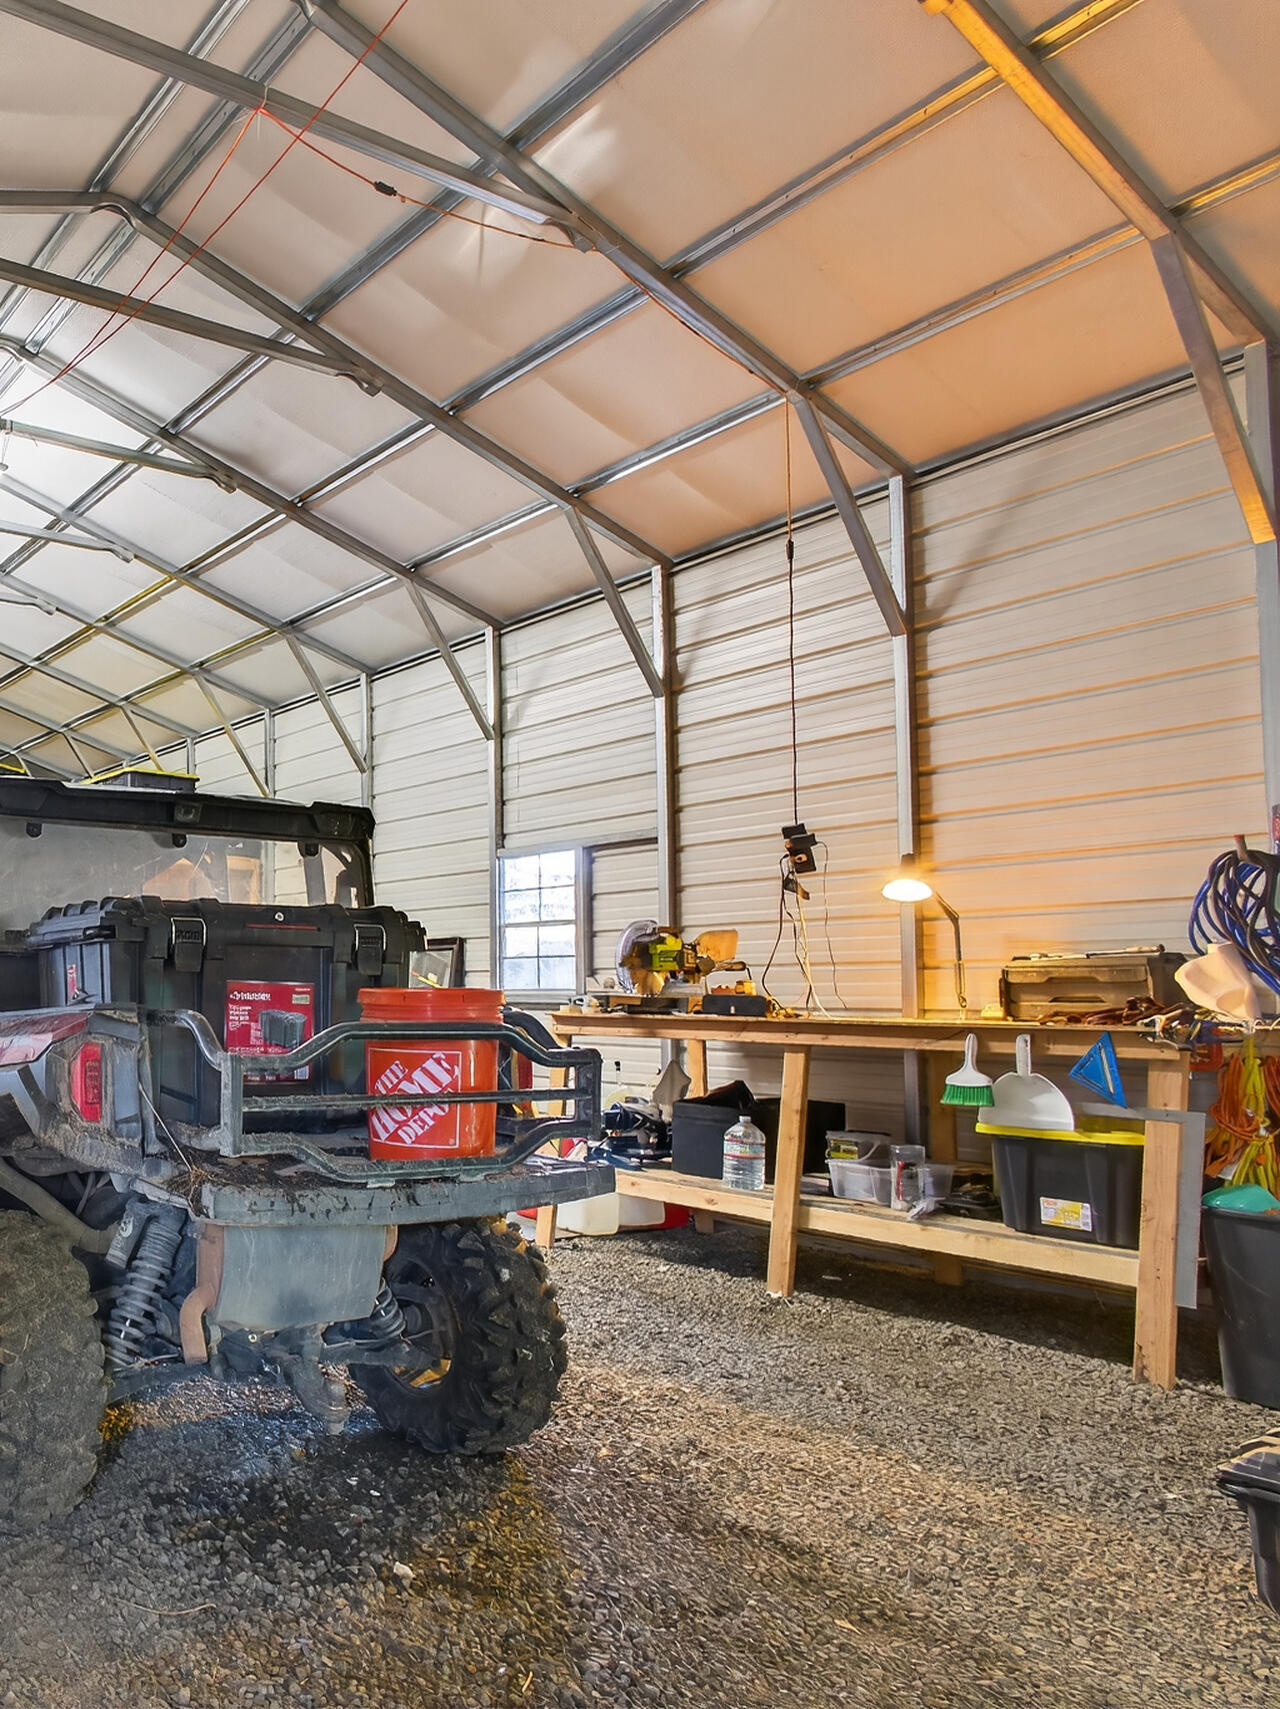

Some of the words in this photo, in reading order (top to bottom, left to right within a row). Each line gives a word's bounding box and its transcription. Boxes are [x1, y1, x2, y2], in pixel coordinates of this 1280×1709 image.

[371, 1051, 460, 1142] HOME
[375, 1060, 409, 1095] THE
[397, 1087, 454, 1145] DEPO
